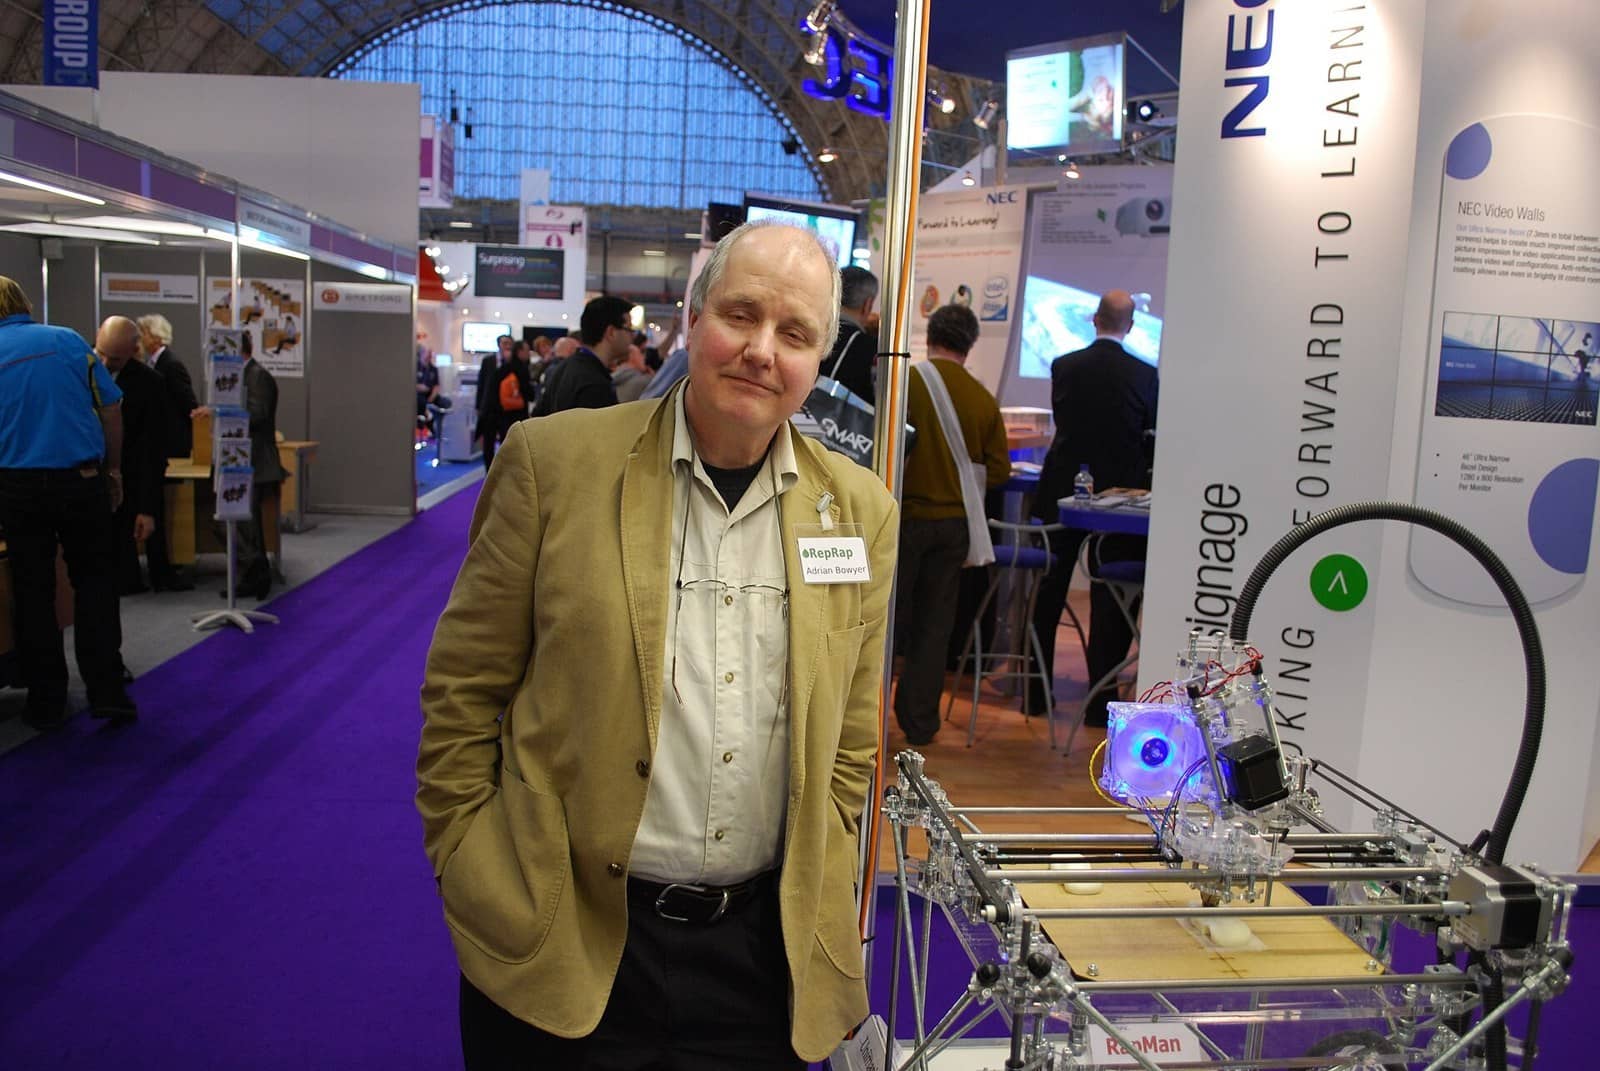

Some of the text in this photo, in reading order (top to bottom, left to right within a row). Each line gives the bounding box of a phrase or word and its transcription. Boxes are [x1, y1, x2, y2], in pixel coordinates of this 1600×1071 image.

[1220, 0, 1275, 139] NE
[987, 190, 1018, 205] NEC
[1458, 201, 1545, 221] NEC Video Walls
[1314, 211, 1352, 270] TO
[1575, 410, 1593, 418] NEC
[808, 546, 854, 560] RepRap
[806, 566, 867, 575] Adrian Bowyer
